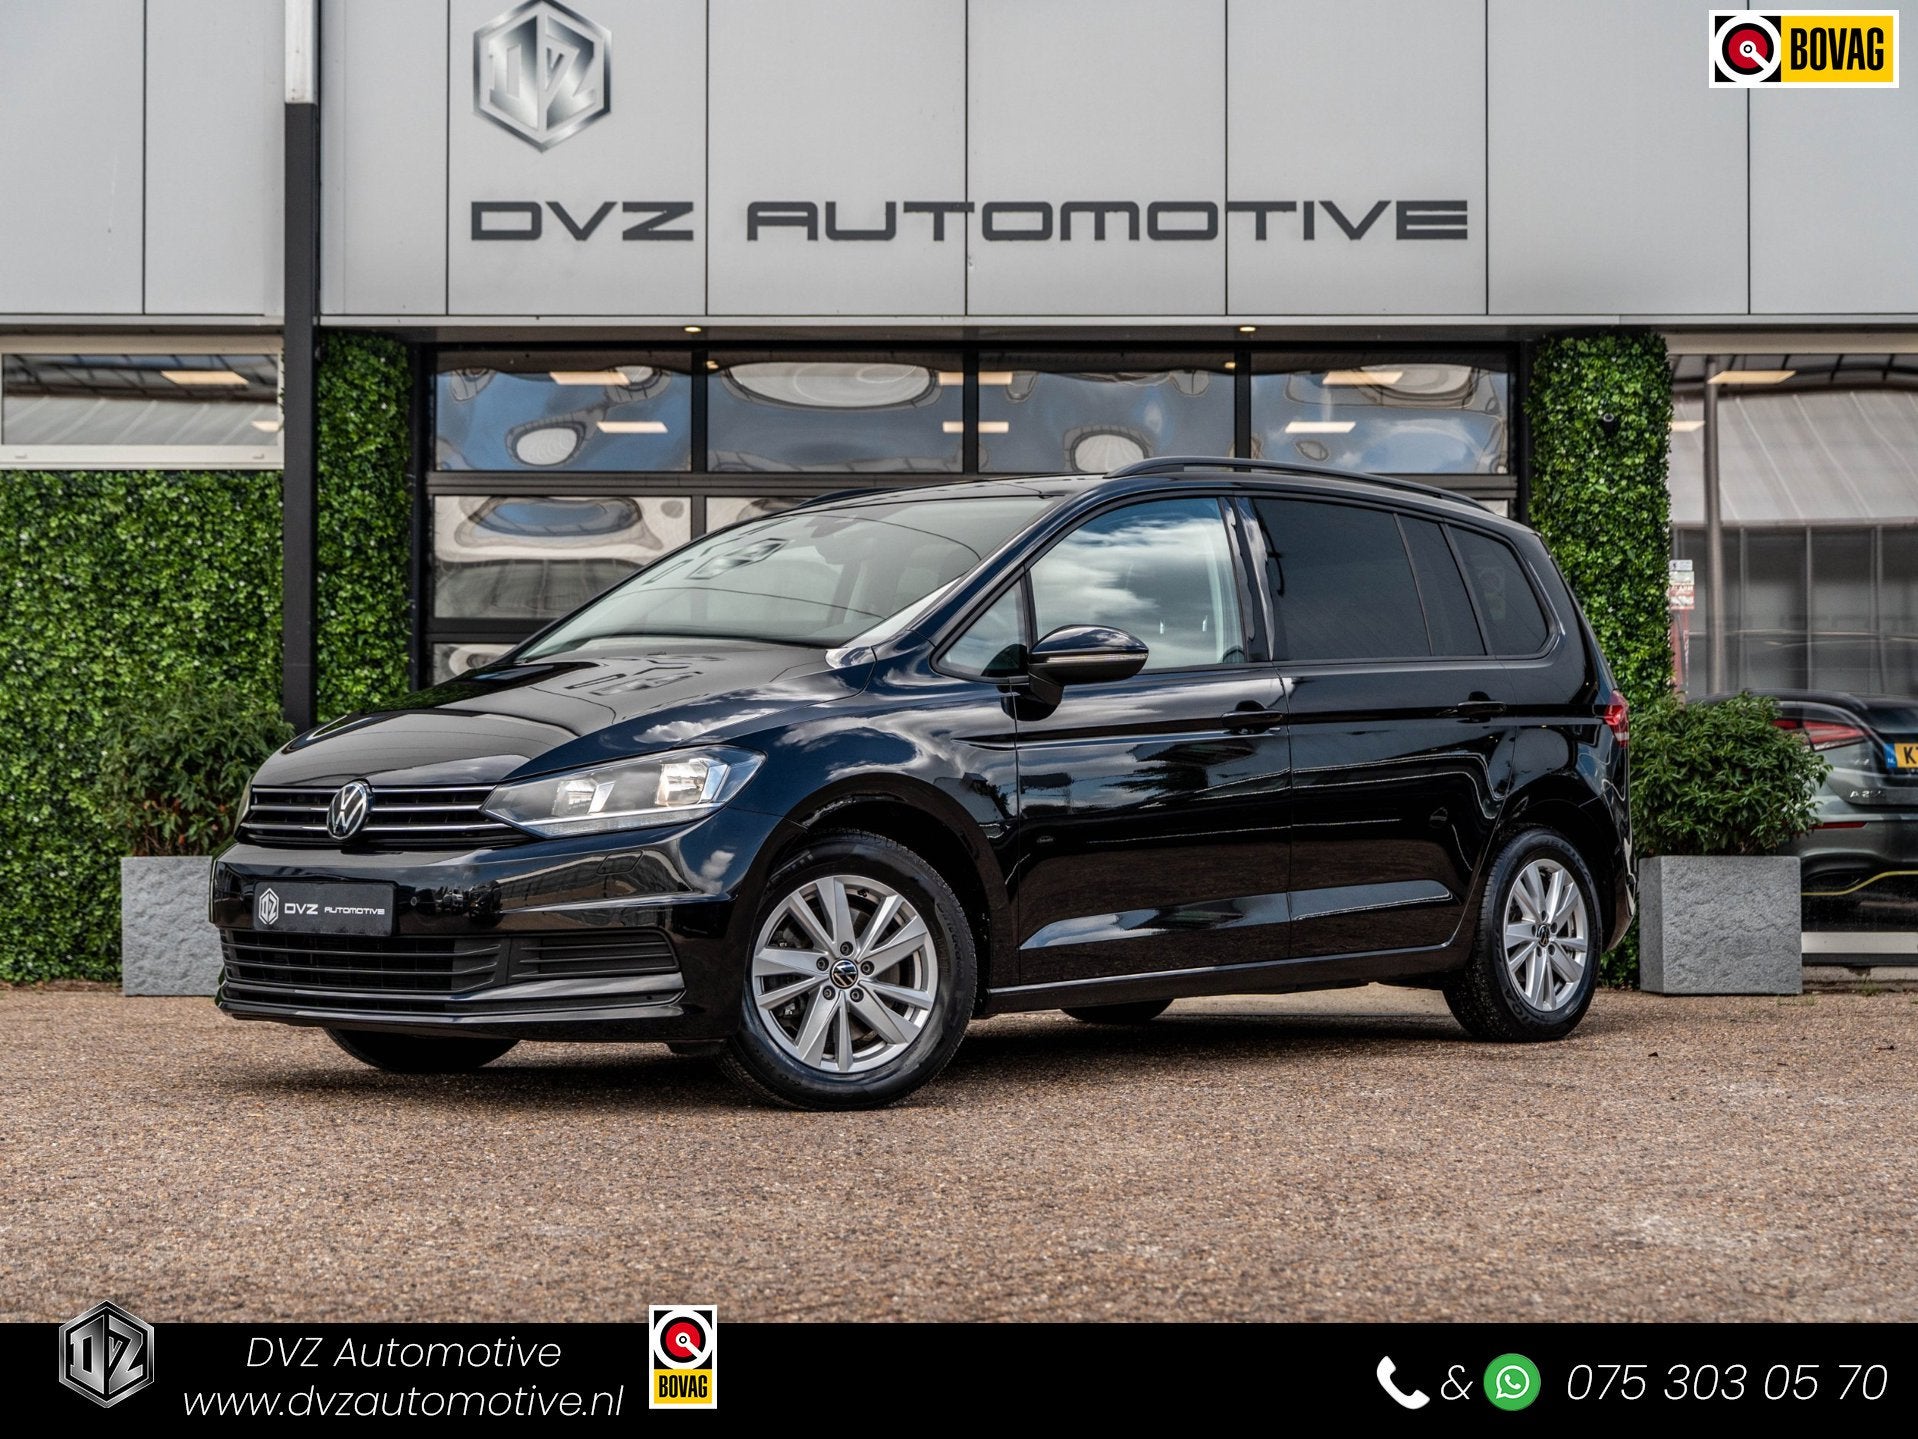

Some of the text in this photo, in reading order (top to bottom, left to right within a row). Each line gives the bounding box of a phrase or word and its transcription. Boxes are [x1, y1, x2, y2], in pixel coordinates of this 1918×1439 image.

[471, 201, 1468, 241] DVZ AUTOMOTIVE
[1903, 746, 1918, 765] K
[284, 902, 386, 915] DVZ AUTOMOTIVE
